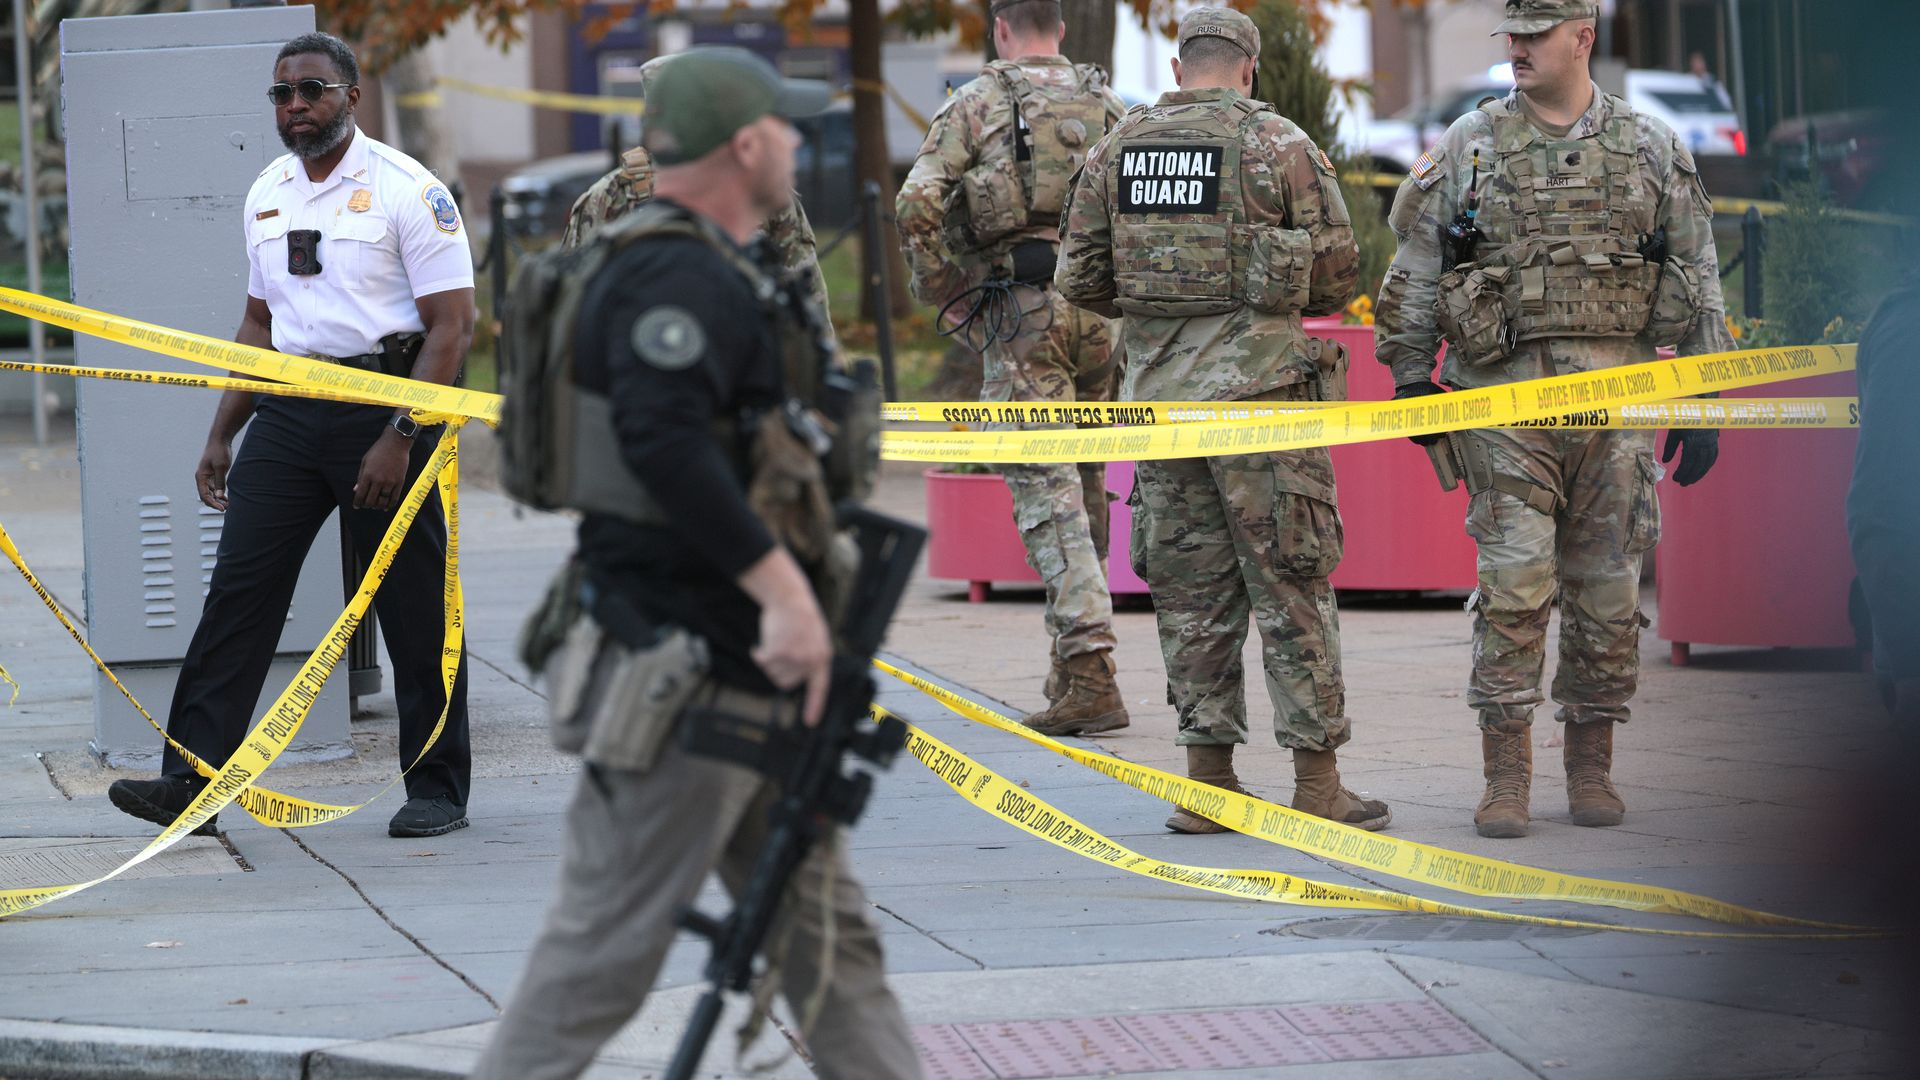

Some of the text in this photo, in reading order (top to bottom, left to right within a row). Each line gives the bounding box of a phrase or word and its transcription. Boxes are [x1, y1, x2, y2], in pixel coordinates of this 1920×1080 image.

[1197, 26, 1222, 34] RUSH
[1122, 152, 1216, 178] NATIONAL
[1130, 180, 1204, 205] GUARD
[1546, 178, 1570, 188] HART
[942, 406, 1156, 424] CRIME SCENE DO NOT CROSS
[1562, 408, 1609, 426] CRIME
[1621, 404, 1669, 426] CROSS
[1672, 404, 1702, 426] NOT
[1706, 404, 1726, 426] DO
[1730, 403, 1776, 425] SCENE
[1780, 402, 1828, 425] CRIME
[262, 612, 360, 744] POLICE LINE DO NOT CROSS
[911, 736, 937, 766] LINE
[930, 750, 972, 787] POLICE
[198, 792, 220, 815] NOT
[213, 764, 252, 796] CROSS
[248, 791, 268, 816] NOT
[270, 798, 284, 823] DO
[285, 802, 310, 824] LINE
[996, 789, 1035, 823] CROSS
[1027, 808, 1057, 834] NOT
[1049, 820, 1072, 841] DO
[1063, 828, 1094, 849] LINE
[1084, 840, 1128, 862] POLICE
[1149, 864, 1188, 880] CROSS
[1203, 873, 1224, 888] DO
[1216, 874, 1246, 892] LINE
[1239, 876, 1276, 896] POLICE
